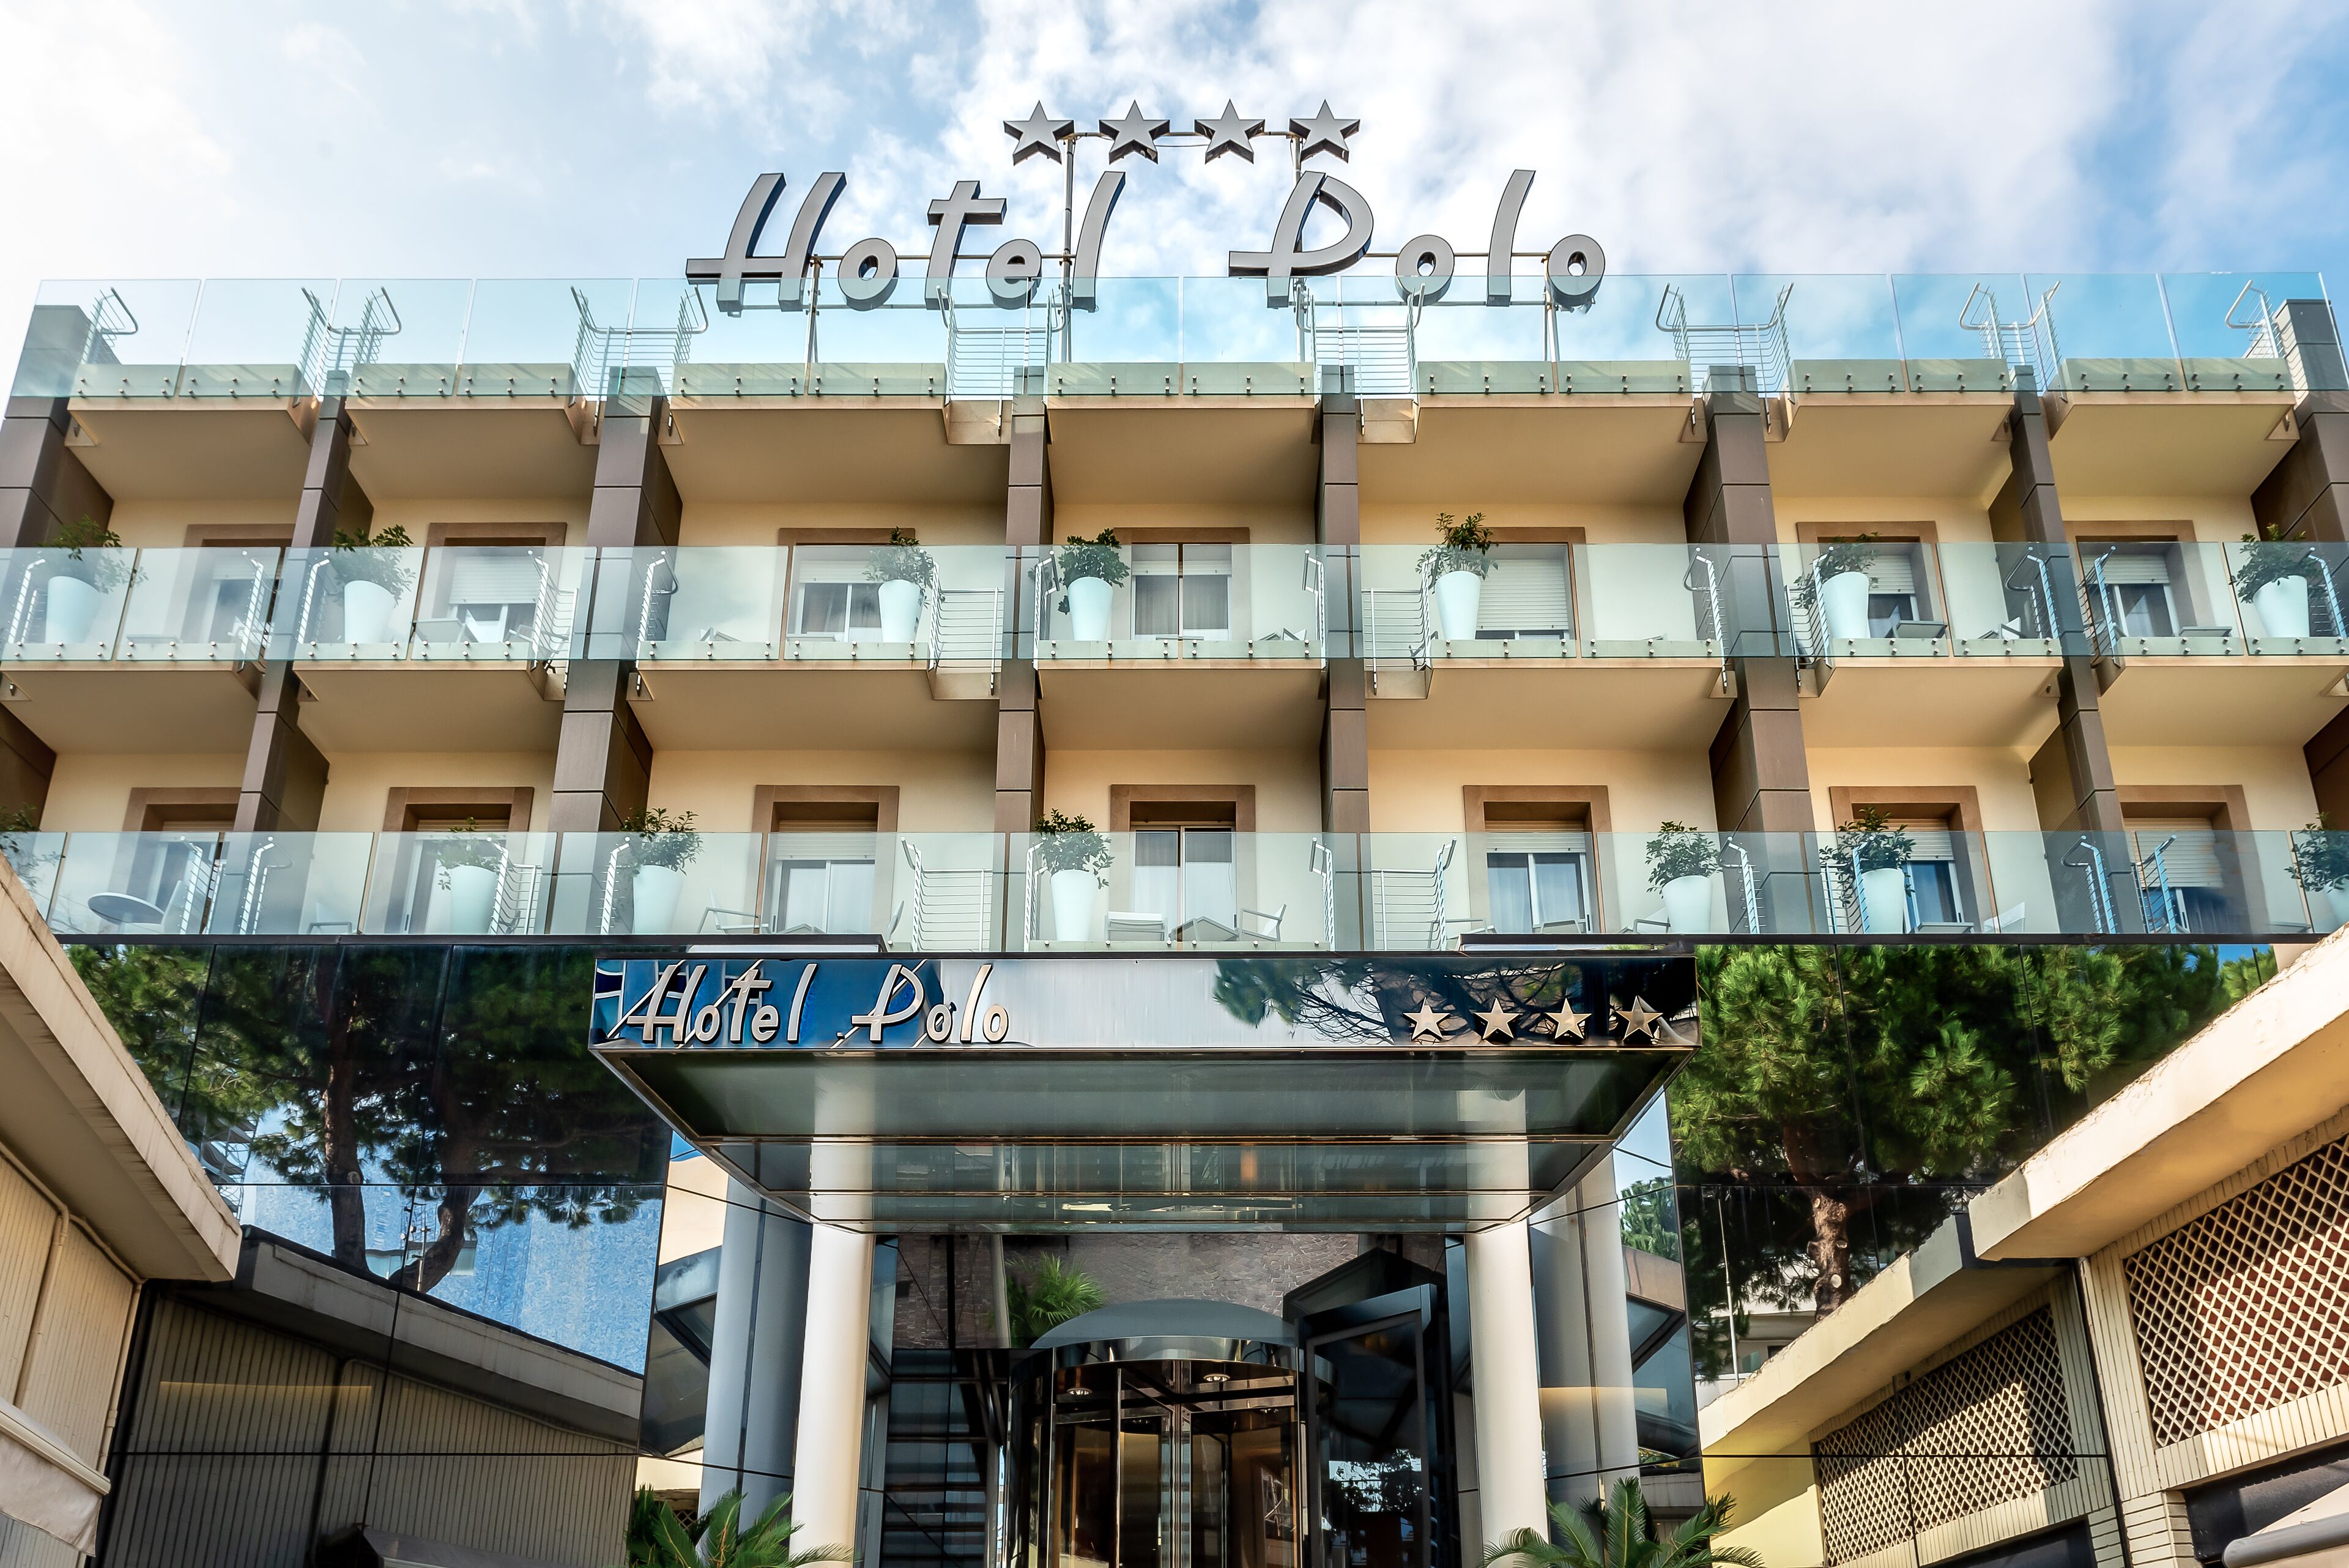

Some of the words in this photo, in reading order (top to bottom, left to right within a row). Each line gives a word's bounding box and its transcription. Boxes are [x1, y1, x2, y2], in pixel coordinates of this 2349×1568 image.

[685, 171, 1126, 313] Hotel
[1228, 169, 1606, 308] Polo
[626, 963, 818, 1044] Hotel
[851, 963, 1009, 1044] Polo
